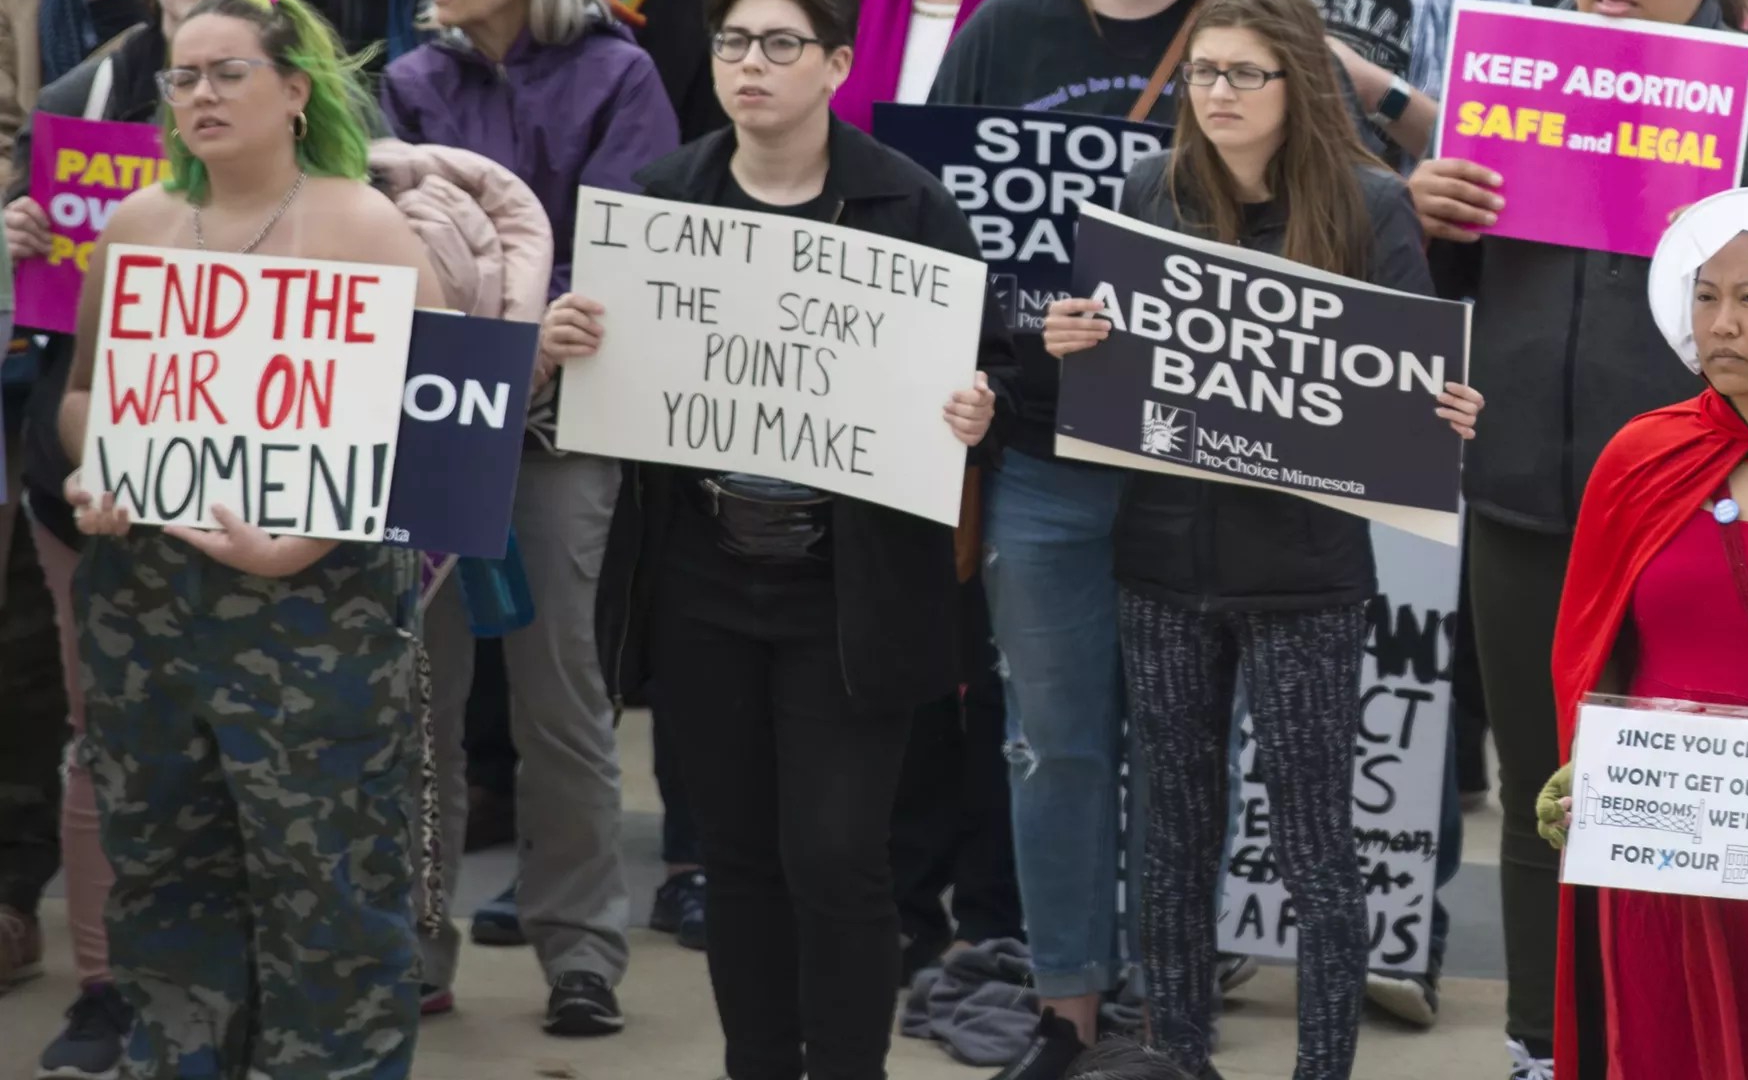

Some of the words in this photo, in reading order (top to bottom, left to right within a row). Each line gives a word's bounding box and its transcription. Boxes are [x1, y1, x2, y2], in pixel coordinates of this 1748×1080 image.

[1462, 51, 1558, 90] KEEP
[1562, 66, 1734, 116] ABORTION
[1456, 101, 1566, 147] SAFE
[1567, 132, 1613, 154] and
[1616, 121, 1722, 169] LEGAL
[590, 200, 628, 249] I
[644, 211, 762, 264] CAN'T
[793, 229, 951, 308] BELIEVE
[111, 254, 249, 341] END
[261, 268, 380, 344] THE
[646, 280, 721, 325] THE
[778, 292, 885, 348] SCARY
[1161, 253, 1344, 330] STOP
[704, 332, 838, 397] POINTS
[1081, 280, 1446, 397] ABORTION
[105, 348, 228, 427] WAR
[255, 353, 336, 431] ON
[1151, 345, 1344, 428] BANS
[662, 390, 737, 453] YOU
[752, 401, 877, 477] MAKE
[1195, 426, 1279, 463] NARAL
[97, 434, 389, 536] WOMEN!
[1195, 449, 1279, 482] Pro-Choice
[1281, 467, 1366, 496] Minnesota
[1616, 728, 1676, 752] SINCE
[1682, 734, 1726, 756] YOU
[1601, 795, 1697, 820] BEDROOMS,
[1607, 765, 1679, 790] WON'T
[1684, 773, 1724, 793] GET
[1610, 842, 1655, 866] FOR
